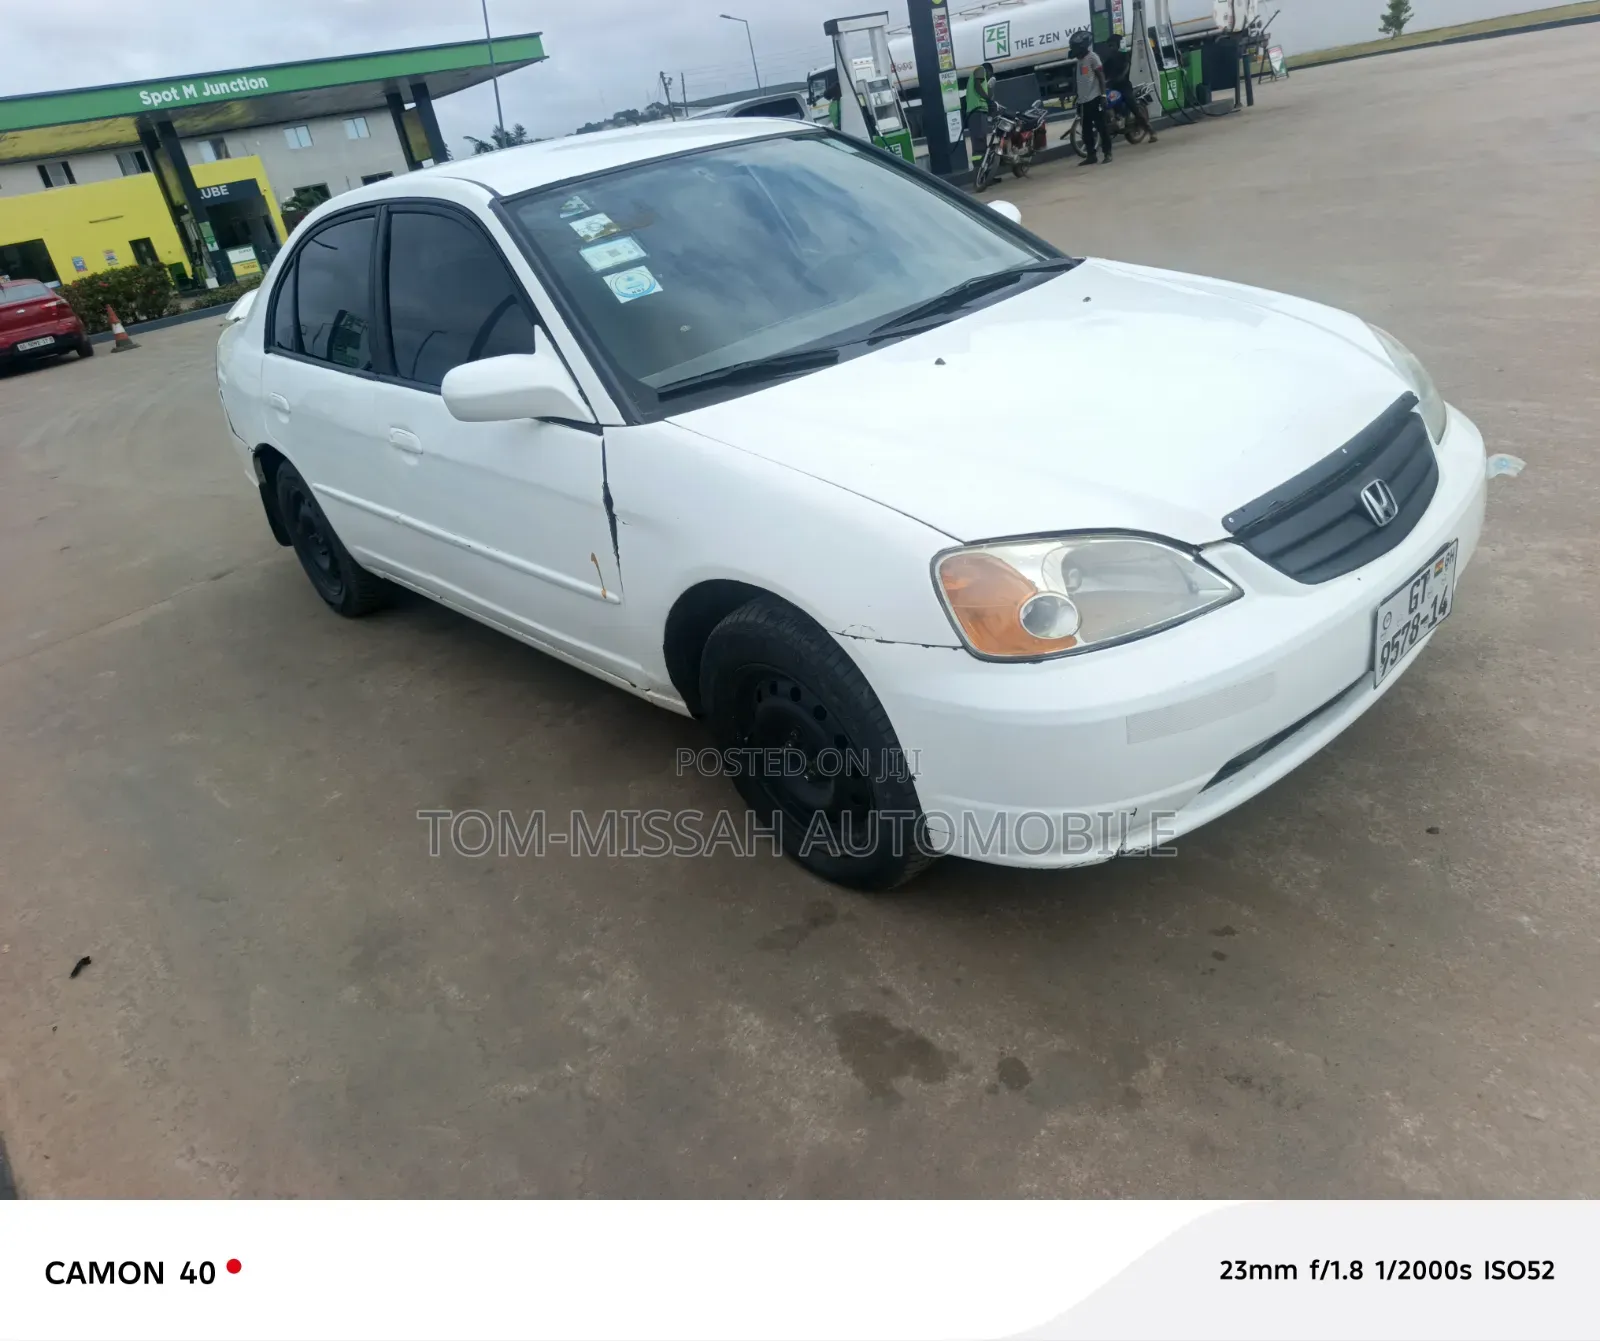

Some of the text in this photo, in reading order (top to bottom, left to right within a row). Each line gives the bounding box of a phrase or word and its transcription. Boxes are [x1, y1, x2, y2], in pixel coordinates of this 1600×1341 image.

[1014, 37, 1035, 50] THE
[1038, 31, 1060, 45] ZEN
[139, 76, 269, 107] Spot M Junction
[200, 185, 230, 200] UBE
[1408, 568, 1431, 615] GT
[1380, 584, 1448, 677] 9578-14
